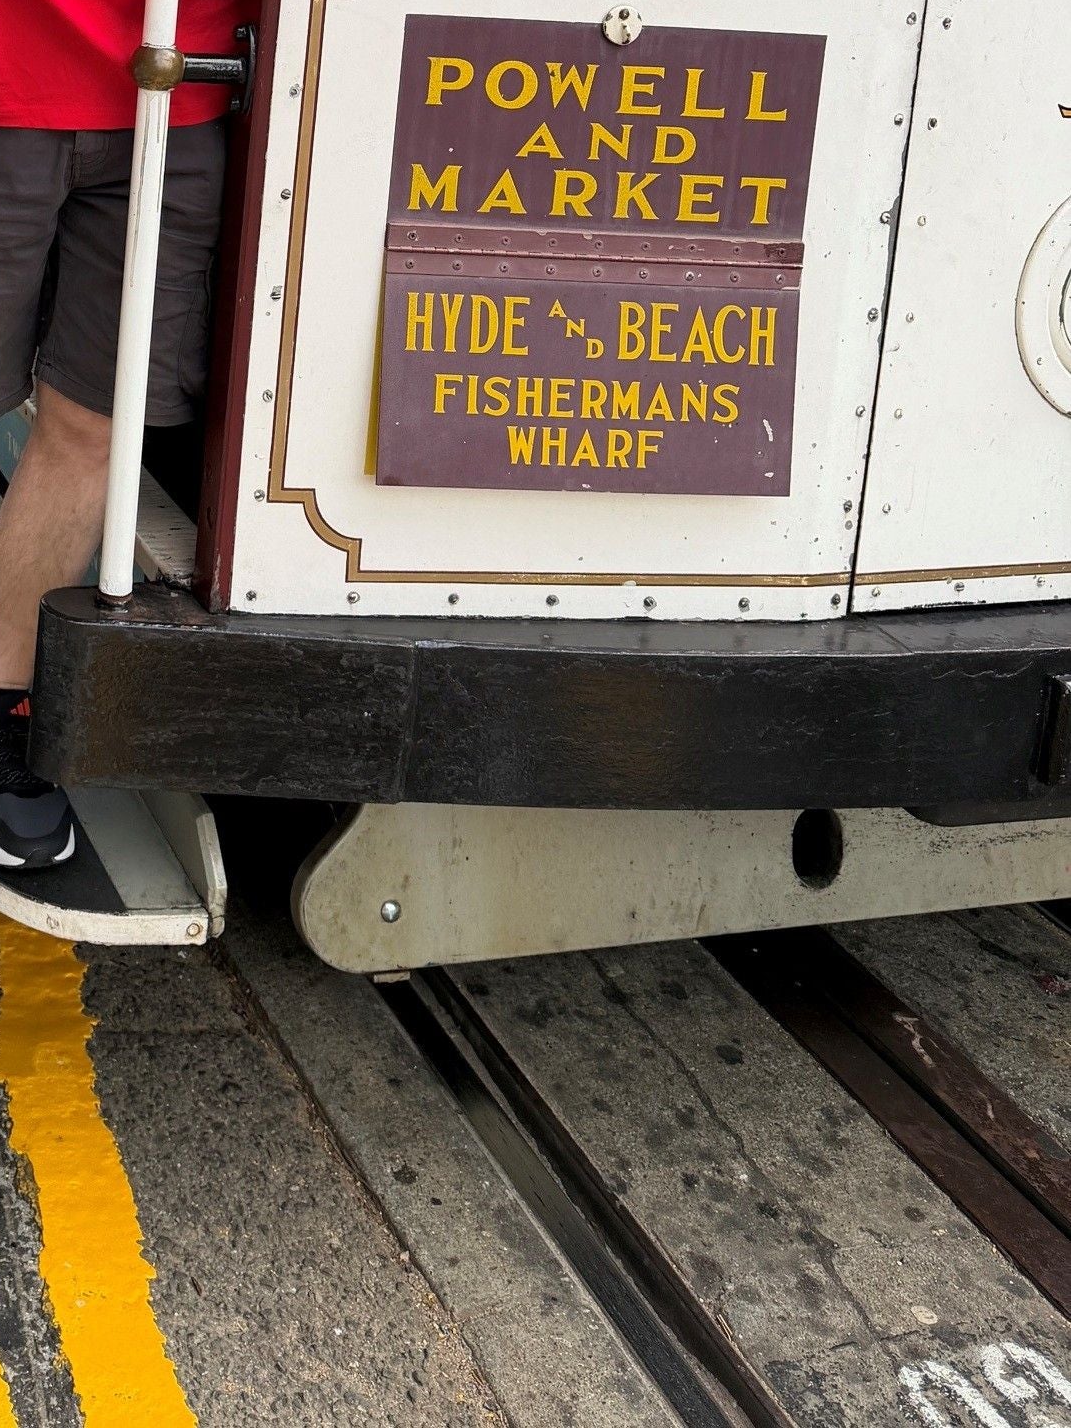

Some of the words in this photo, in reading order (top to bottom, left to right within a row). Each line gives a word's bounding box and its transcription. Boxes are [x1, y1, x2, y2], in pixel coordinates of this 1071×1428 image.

[424, 56, 787, 122] POWELL
[516, 122, 697, 164] AND
[407, 163, 787, 225] MARKET
[404, 292, 530, 357] HYDE
[547, 300, 605, 360] AND
[616, 301, 778, 367] BEACH
[432, 373, 740, 425] FISHERMANS
[506, 425, 664, 470] WHARF
